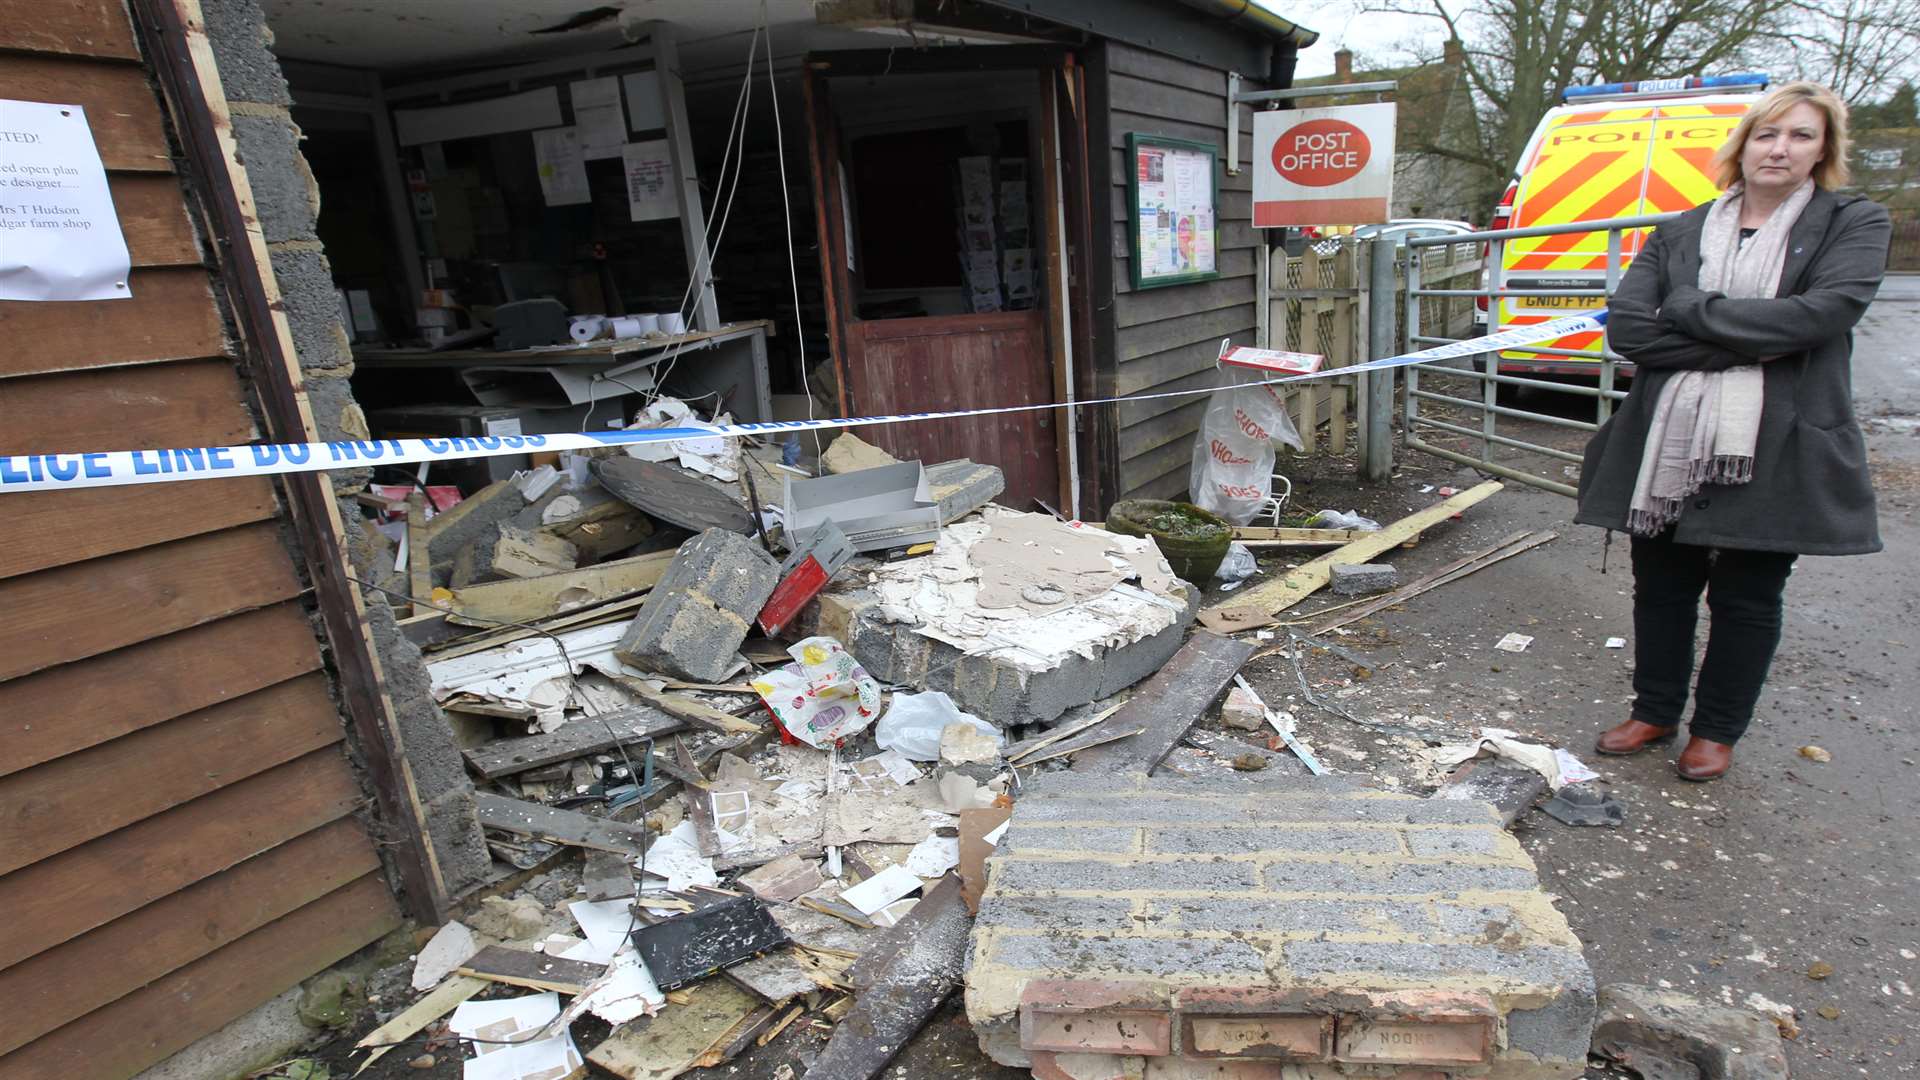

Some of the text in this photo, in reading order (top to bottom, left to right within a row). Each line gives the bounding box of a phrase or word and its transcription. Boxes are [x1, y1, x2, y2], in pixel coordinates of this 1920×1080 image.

[1640, 80, 1683, 93] POLICE
[0, 131, 41, 144] TED!
[1294, 132, 1351, 151] POST
[1280, 151, 1357, 171] OFFICE
[20, 165, 50, 176] open
[53, 166, 78, 176] plan
[33, 205, 80, 215] Hudson
[30, 218, 59, 228] farm
[62, 219, 92, 230] shop
[132, 447, 235, 474] LINE
